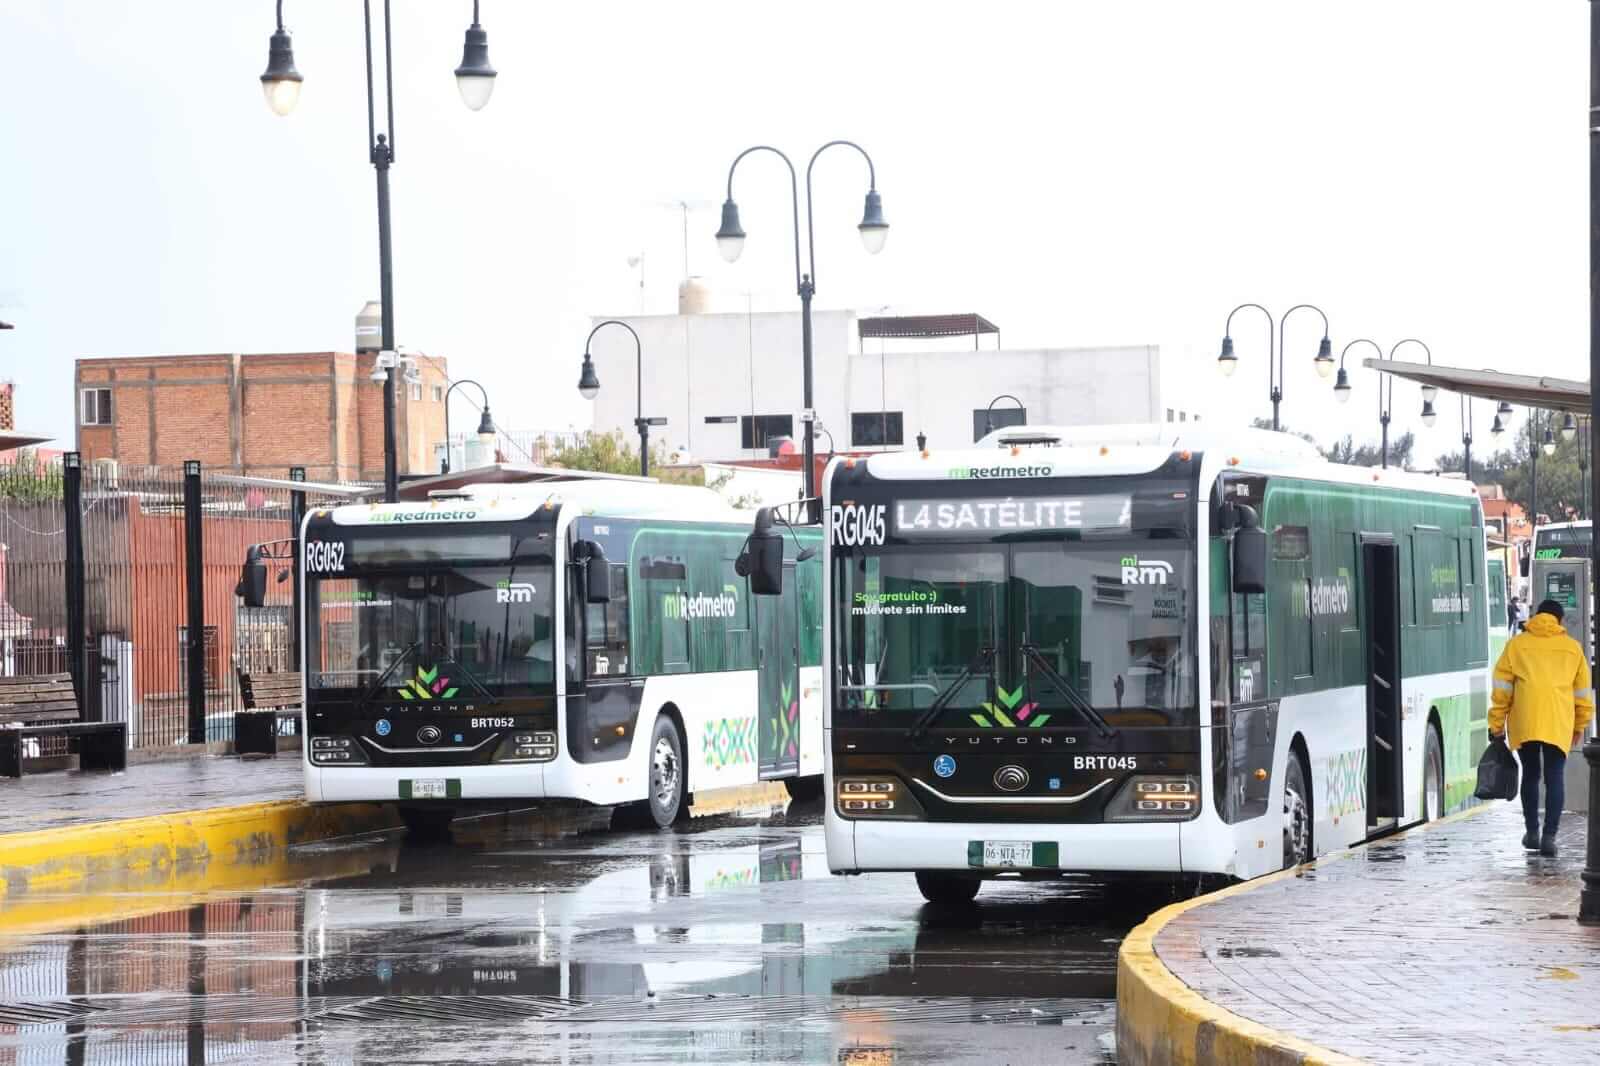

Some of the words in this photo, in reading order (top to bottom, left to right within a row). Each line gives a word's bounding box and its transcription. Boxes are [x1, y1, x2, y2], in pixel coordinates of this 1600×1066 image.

[896, 502, 932, 529] L4
[938, 497, 1082, 528] SATÉLITE
[831, 504, 886, 546] RG045
[306, 541, 345, 572] RG052
[906, 604, 924, 615] sin
[471, 717, 515, 728] BRT052
[1073, 756, 1137, 770] BRT045
